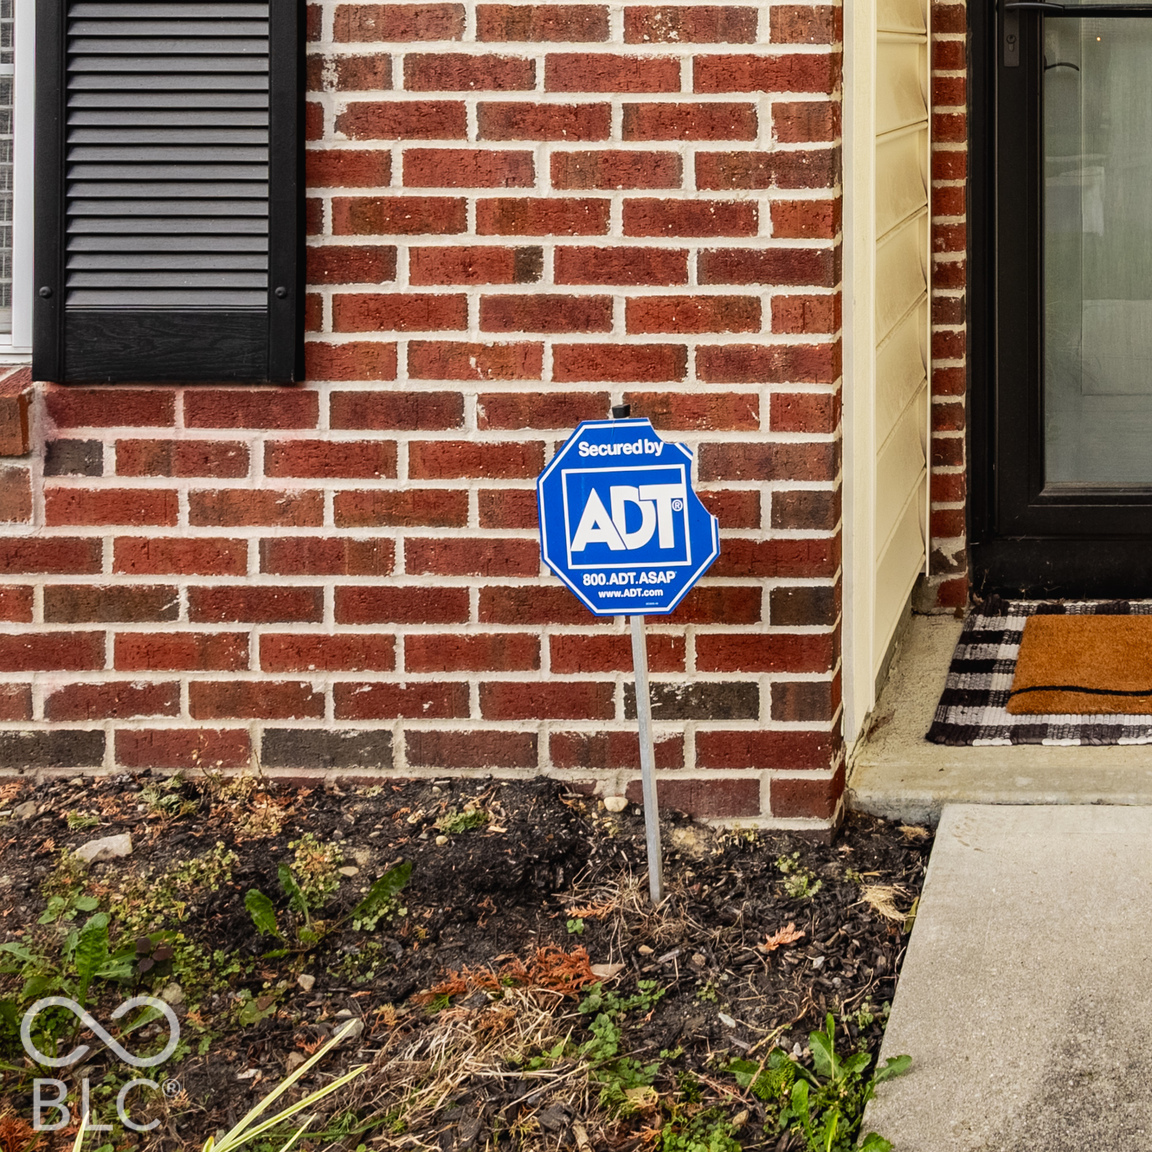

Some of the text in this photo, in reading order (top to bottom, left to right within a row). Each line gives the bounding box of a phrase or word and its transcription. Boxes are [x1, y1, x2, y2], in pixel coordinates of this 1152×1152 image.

[578, 438, 664, 457] Secured by
[582, 571, 677, 586] 800.ADT.ASAP
[598, 588, 664, 598] www.ADT.com
